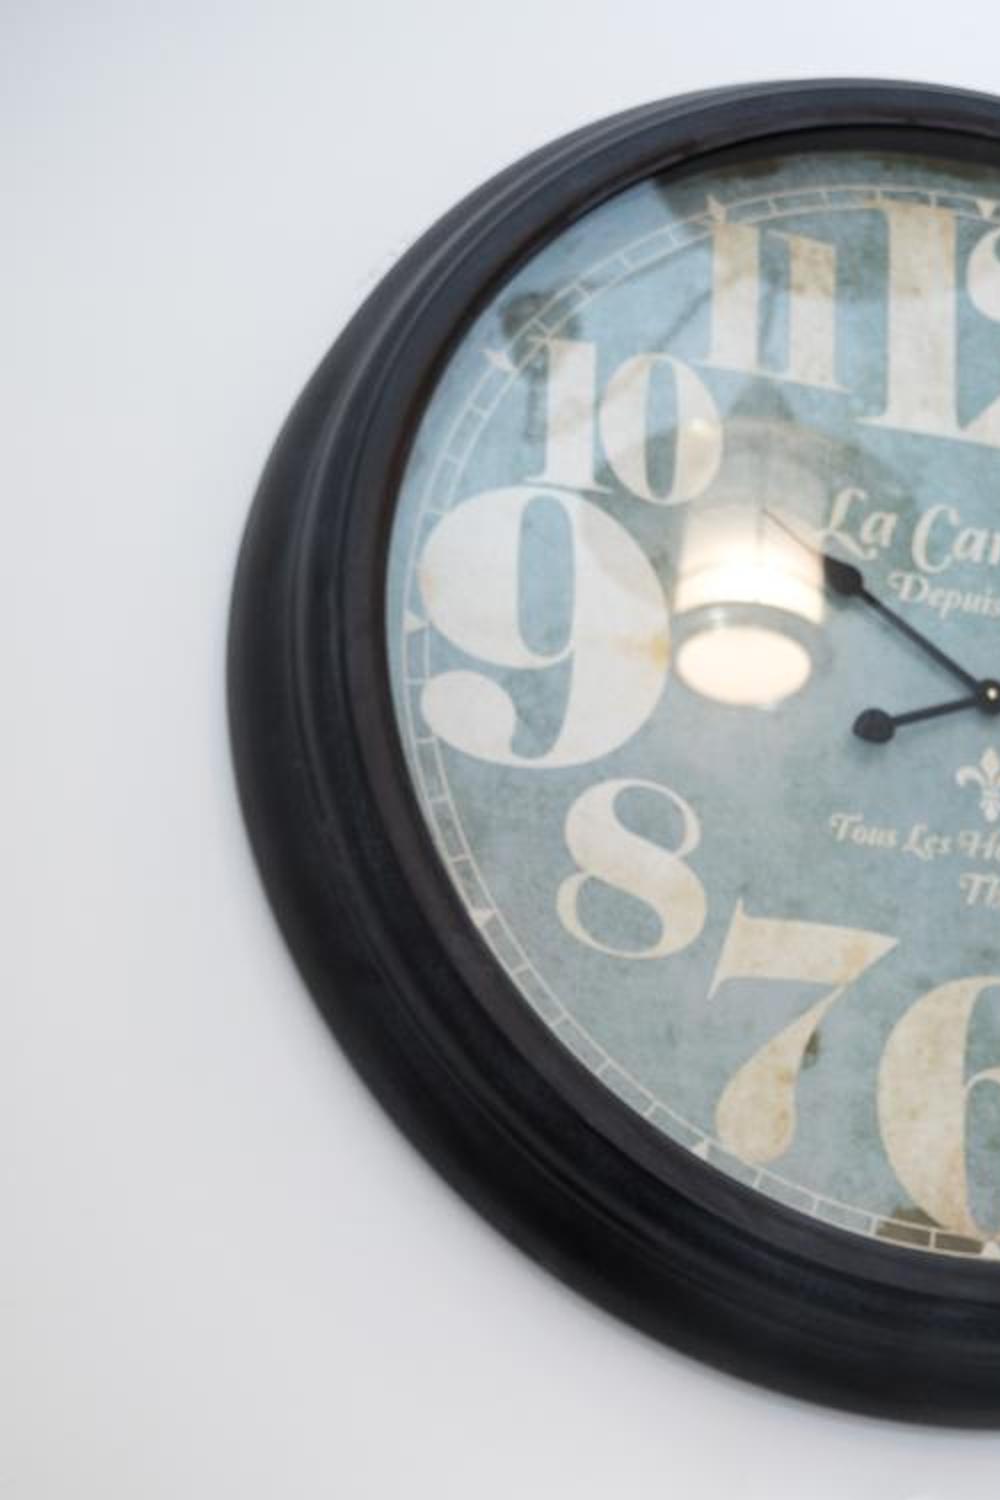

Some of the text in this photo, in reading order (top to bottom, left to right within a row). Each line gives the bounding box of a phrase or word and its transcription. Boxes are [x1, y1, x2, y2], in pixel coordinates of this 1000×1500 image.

[690, 219, 855, 394] 11
[524, 335, 724, 505] 10
[816, 486, 898, 562] La
[417, 485, 672, 769] 9
[555, 777, 708, 960] 8
[829, 811, 897, 847] Tous
[901, 822, 951, 861] Les
[706, 898, 900, 1165] 7
